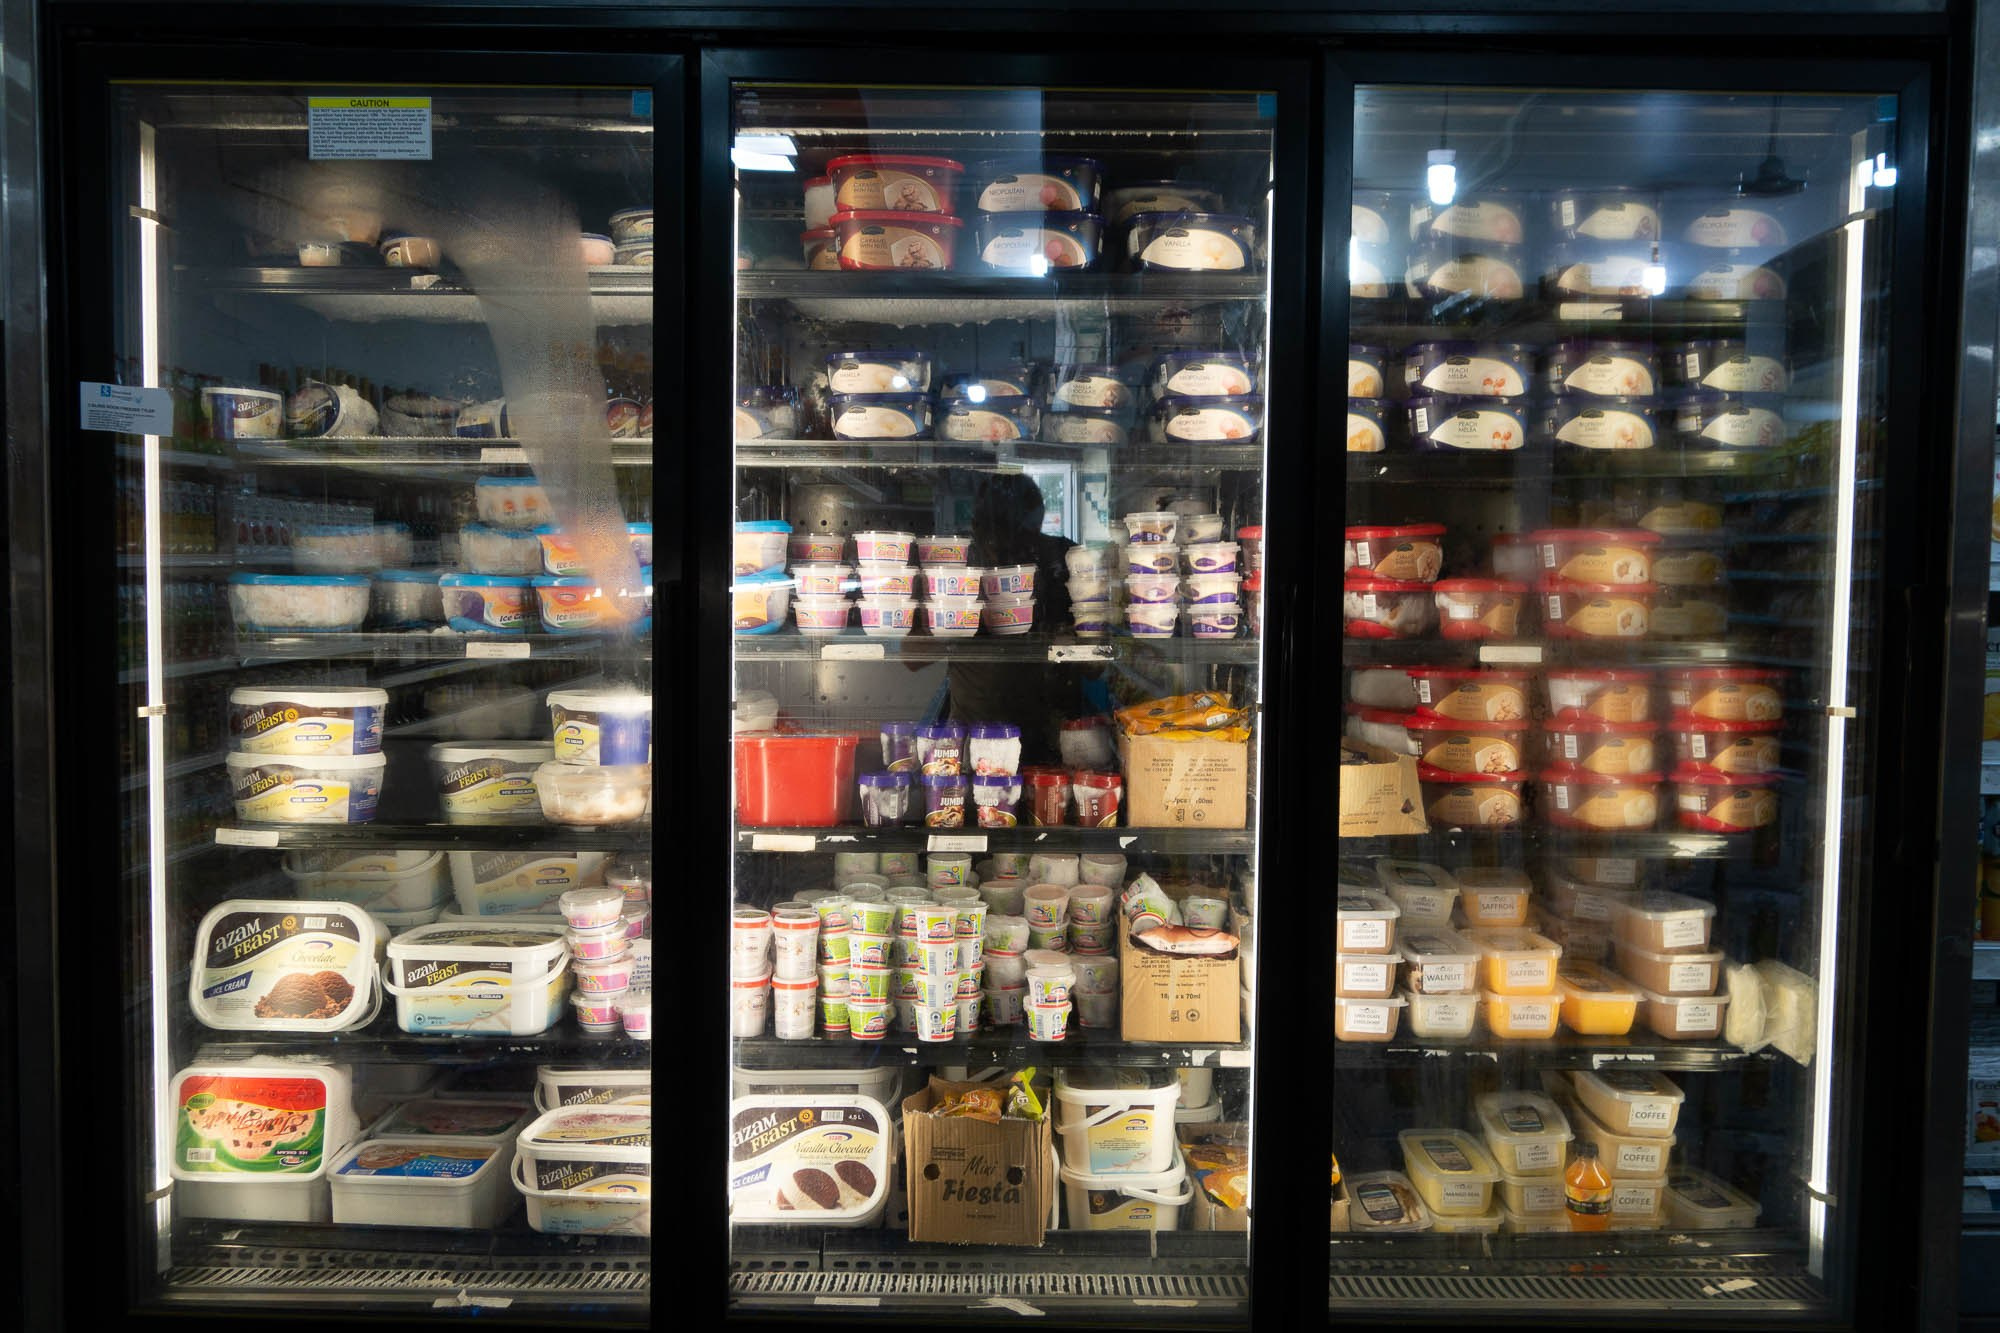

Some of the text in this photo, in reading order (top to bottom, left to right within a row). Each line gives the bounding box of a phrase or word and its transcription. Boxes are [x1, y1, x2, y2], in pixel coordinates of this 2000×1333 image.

[243, 709, 266, 729] azam
[934, 749, 959, 759] JUMBO
[238, 770, 261, 791] azam
[443, 766, 471, 786] azam
[459, 769, 489, 789] FEAST
[940, 797, 964, 807] JUMBO
[215, 918, 262, 953] azam
[233, 924, 281, 960] FEAST
[292, 951, 337, 963] Chocolate
[408, 961, 438, 983] azam
[427, 963, 459, 986] FEAST
[1427, 974, 1462, 982] WALNUT
[224, 977, 247, 992] CREAM
[564, 1088, 594, 1107] azam
[1635, 1112, 1668, 1120] COFFEE
[734, 1113, 778, 1147] azam
[750, 1117, 798, 1153] FEAST
[794, 1141, 874, 1153] Vanilla Chocolate
[963, 1155, 999, 1177] Mini
[1624, 1153, 1656, 1163] COFFEE
[542, 1164, 573, 1186] azam
[562, 1166, 595, 1190] FEAST
[742, 1171, 766, 1184] CREAM
[943, 1179, 1020, 1205] Fiesta
[1619, 1197, 1650, 1206] COFFEE
